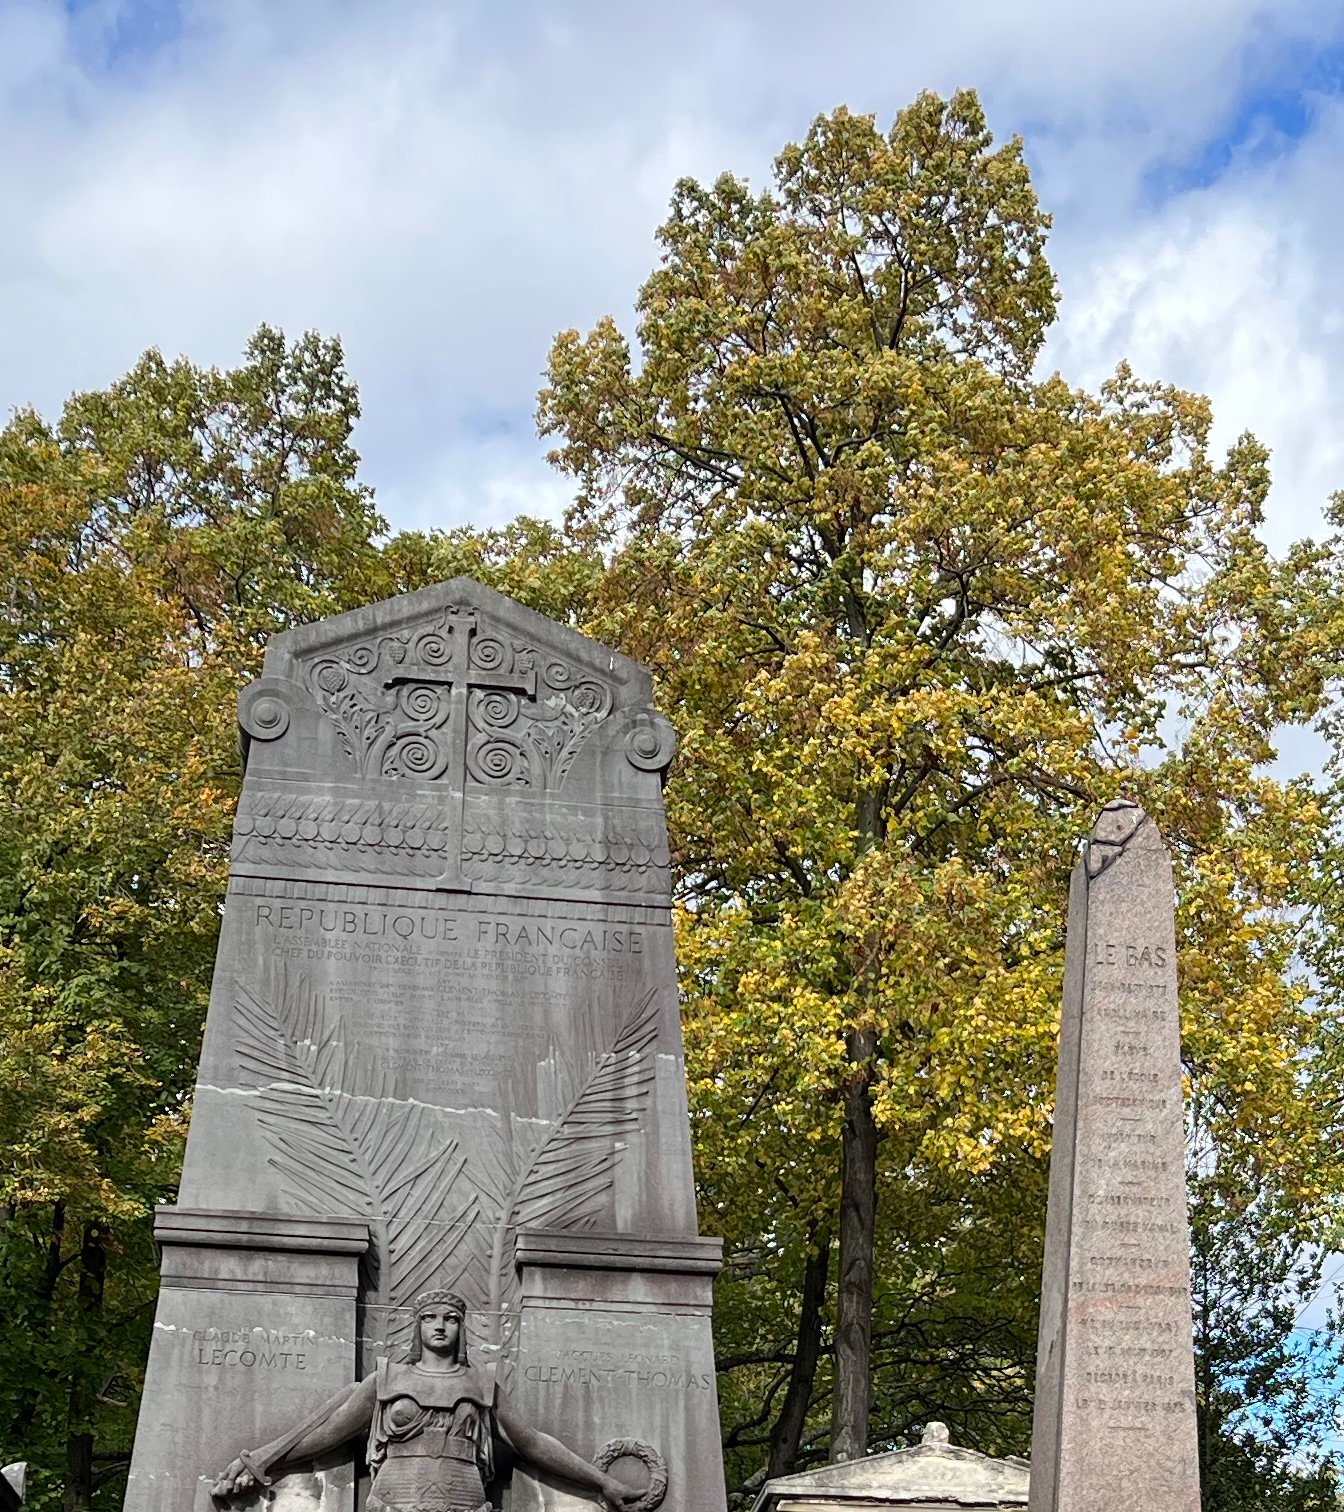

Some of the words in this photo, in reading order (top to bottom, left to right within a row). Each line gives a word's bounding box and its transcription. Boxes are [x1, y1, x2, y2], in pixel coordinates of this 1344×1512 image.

[256, 905, 458, 941] REPUBLIQUE
[477, 920, 643, 953] FRANCAISE
[272, 947, 302, 959] CHEF
[308, 949, 324, 960] DU
[327, 951, 382, 964] POUVOIR
[1094, 943, 1116, 965] LE
[1126, 945, 1168, 968] BAS
[261, 1335, 317, 1346] MARTIN
[197, 1348, 307, 1370] LECOMTE
